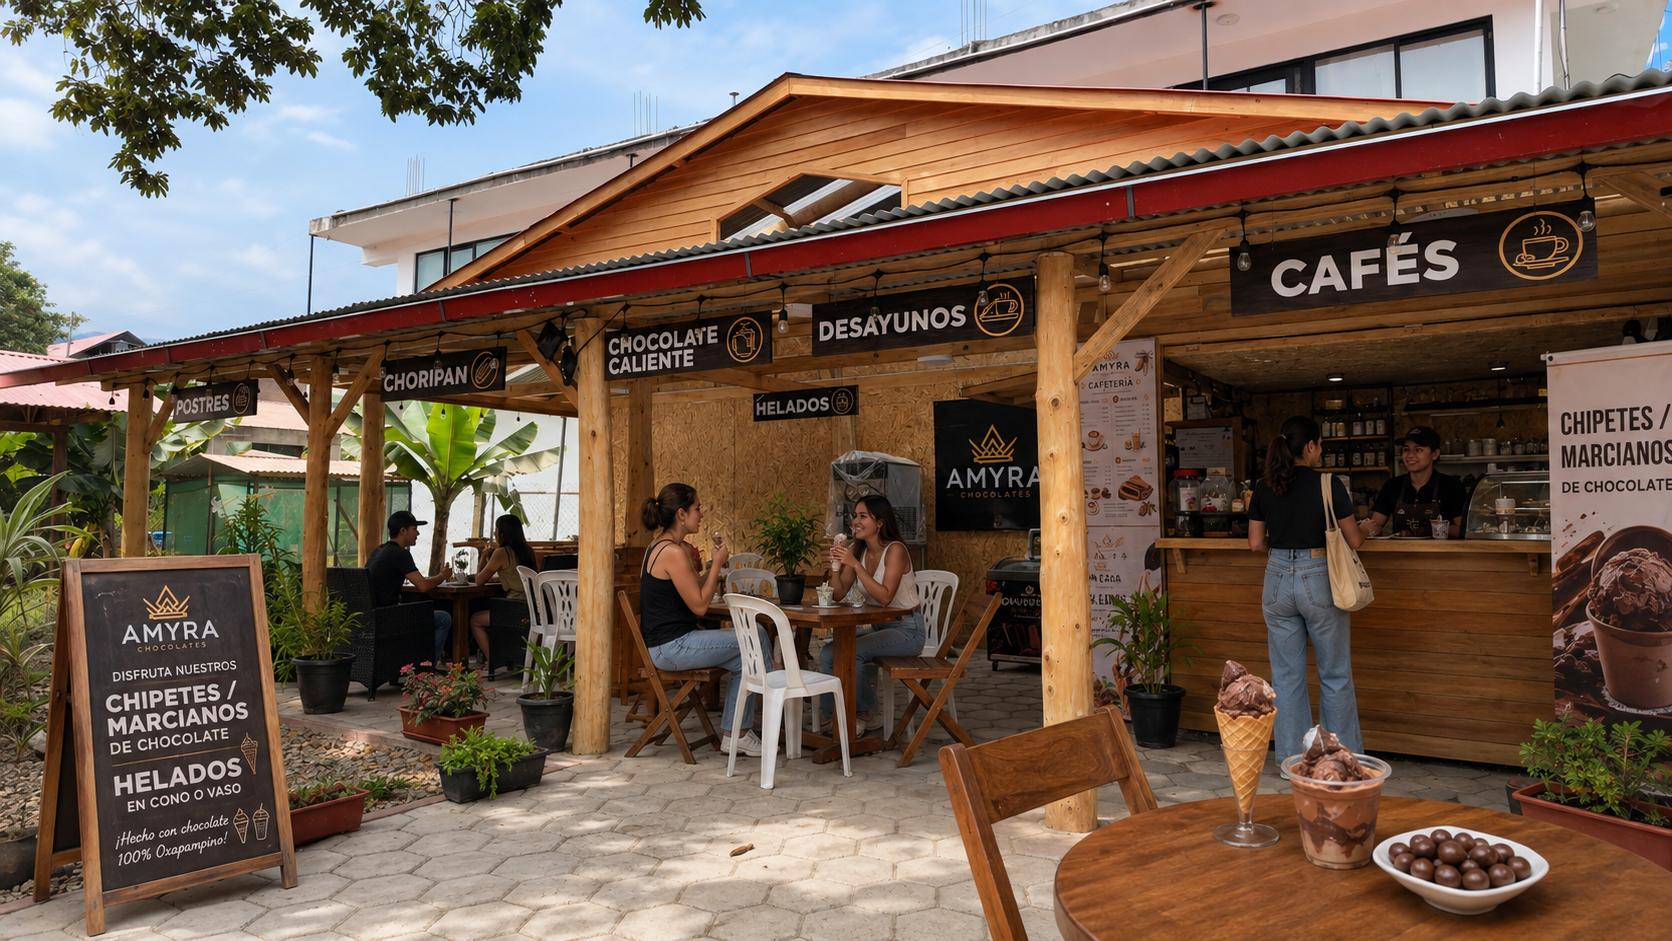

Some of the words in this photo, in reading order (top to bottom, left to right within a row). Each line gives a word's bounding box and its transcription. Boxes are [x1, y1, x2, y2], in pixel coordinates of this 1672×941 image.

[1270, 231, 1460, 298] CAFÉS
[818, 304, 967, 342] DESAYUNOS
[607, 324, 719, 356] CHOCOLATE
[607, 349, 694, 375] CALIENTE
[1092, 361, 1130, 372] AMYRA
[383, 365, 468, 393] CHORIPAN
[175, 393, 230, 416] POSTRES
[756, 396, 830, 416] HELADOS
[1560, 405, 1654, 436] CHIPETES
[1658, 403, 1671, 430] /
[1561, 439, 1672, 468] MARCIANOS
[946, 465, 1041, 489] AMYRA
[1561, 481, 1580, 494] DE
[1584, 478, 1672, 493] CHOCOLATE
[960, 490, 1031, 499] CHOCOLATES
[121, 619, 220, 645] AMYRA
[137, 641, 207, 653] CHOCOLATES
[112, 667, 173, 682] DISFRUTA
[175, 660, 237, 676] NUESTROS
[105, 683, 221, 713] CHIPETES
[226, 680, 237, 700] /
[107, 701, 249, 737] MARCIANOS
[109, 740, 132, 755] DE
[137, 727, 229, 751] CHOCOLATE
[113, 757, 242, 797] HELADOS
[127, 799, 146, 813] EN
[150, 791, 190, 808] CONO
[193, 789, 204, 801] O
[207, 783, 242, 798] VASO
[115, 828, 155, 850] ¡Hecho
[158, 828, 178, 839] con
[180, 815, 229, 833] chocolate
[117, 847, 152, 866] 100%
[156, 831, 228, 859] Oxapampino!
